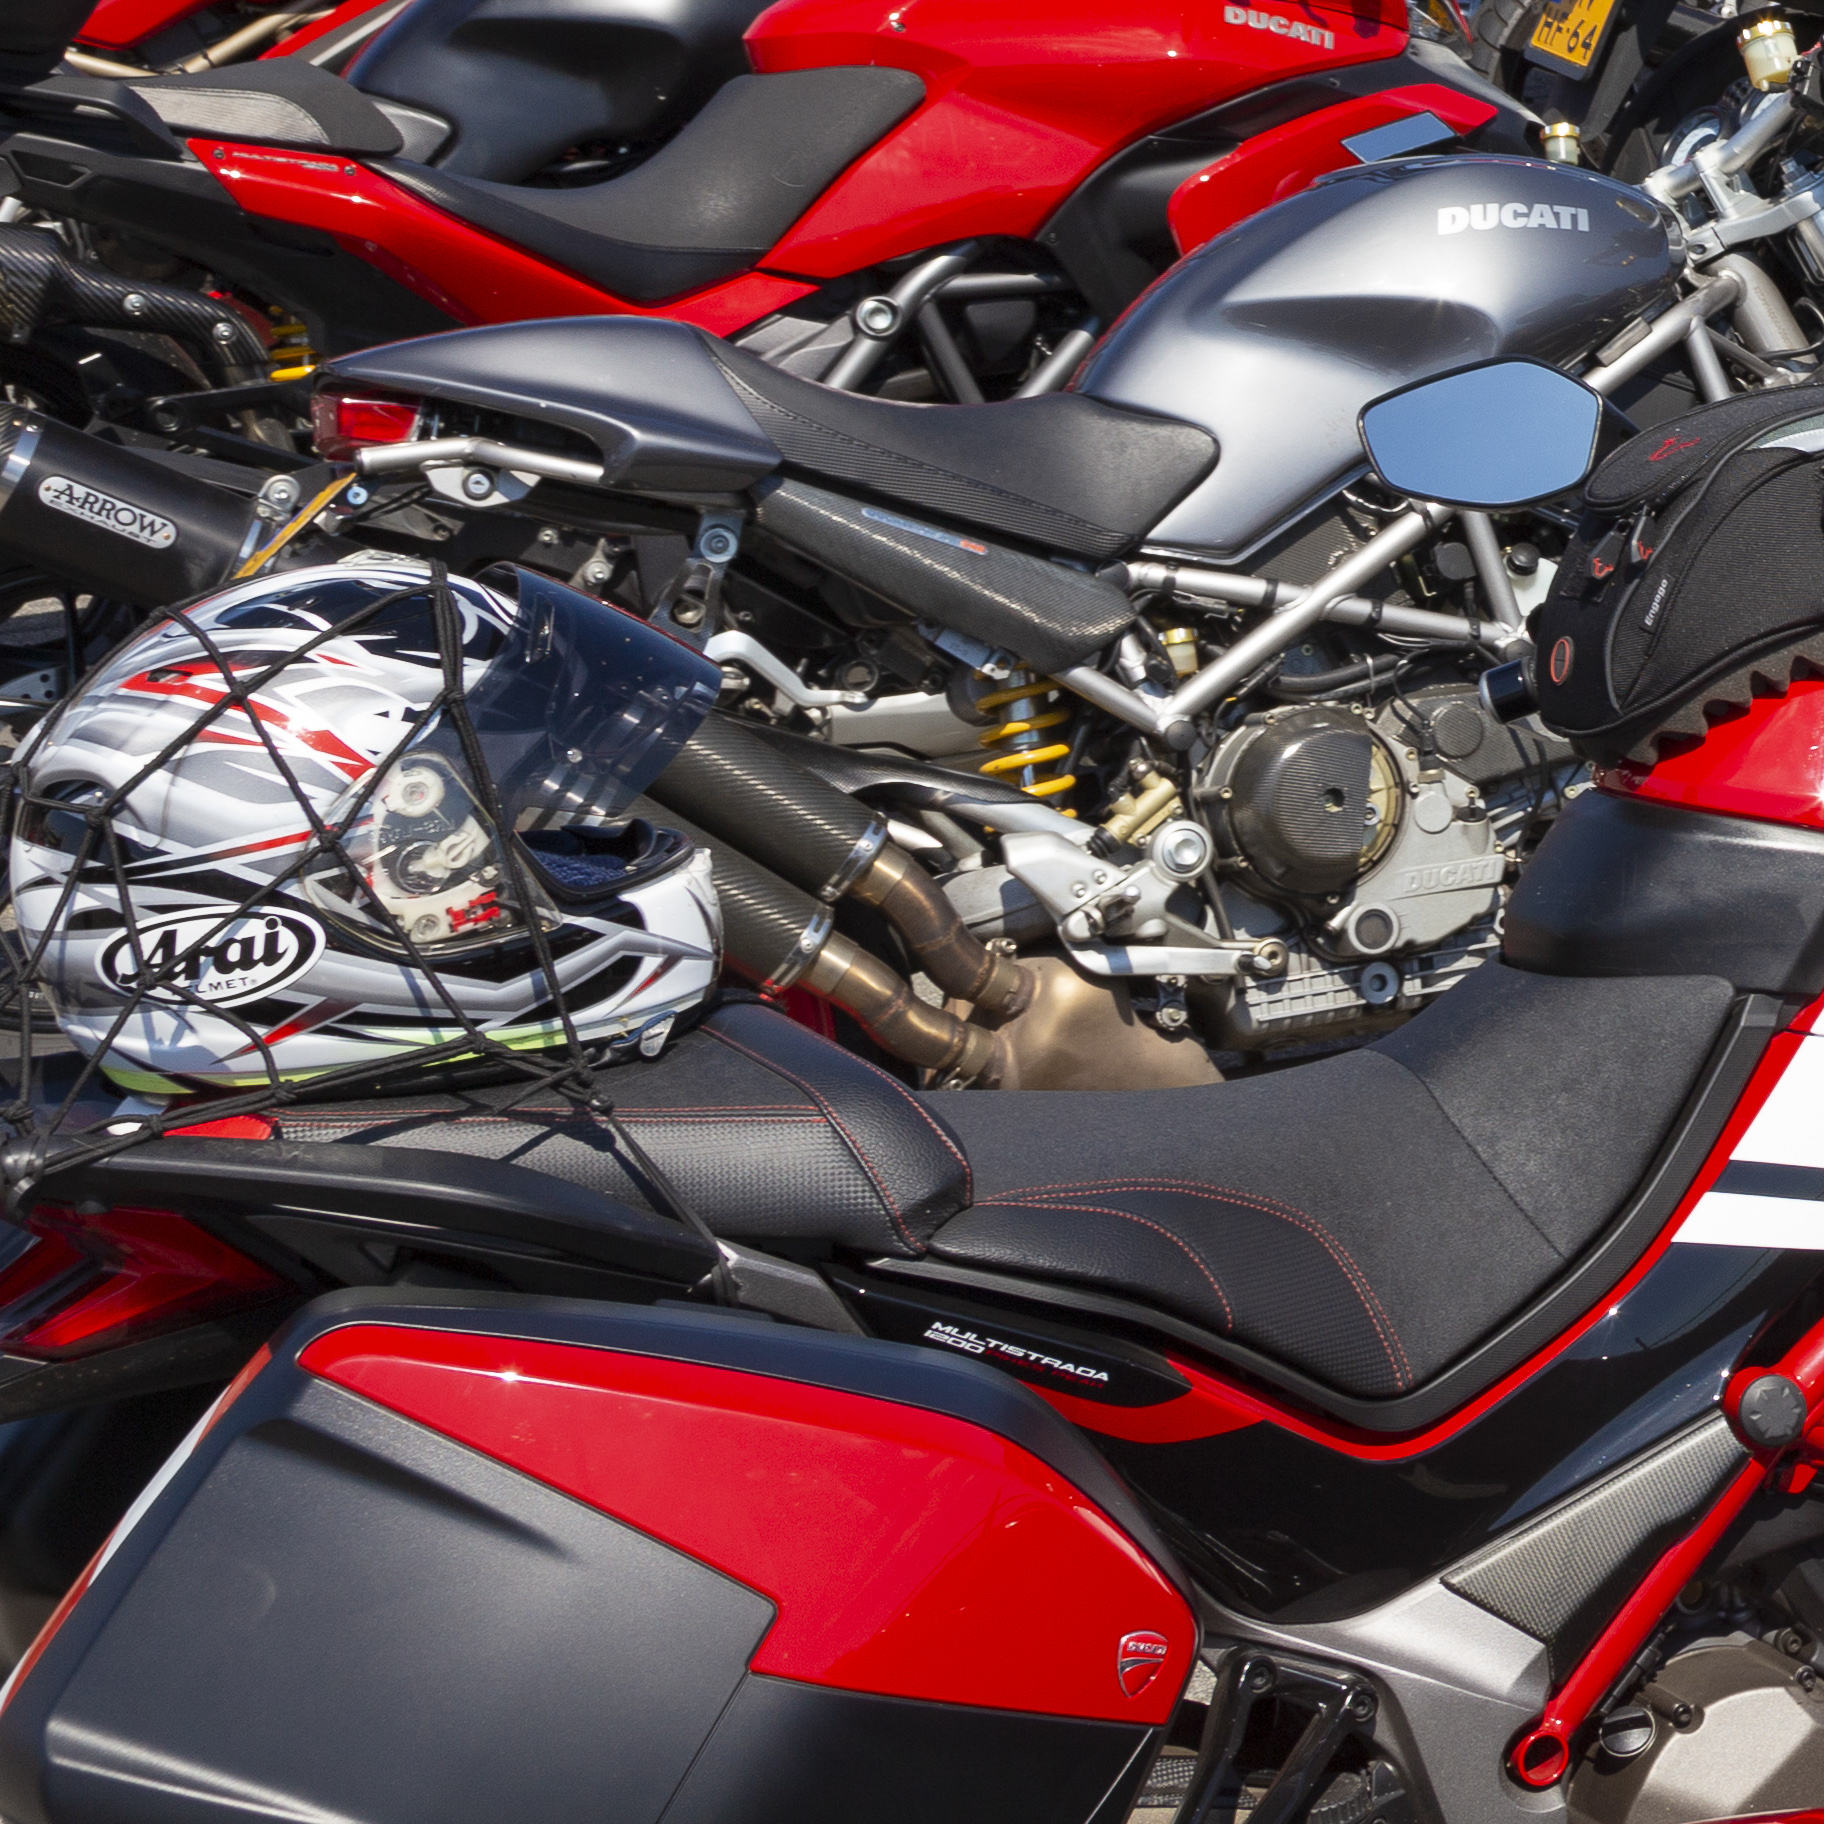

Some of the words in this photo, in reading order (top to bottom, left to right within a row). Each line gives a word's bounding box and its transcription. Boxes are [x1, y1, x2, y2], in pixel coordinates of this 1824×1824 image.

[1224, 5, 1335, 50] DUCATI
[1536, 8, 1598, 61] HF-64
[1436, 202, 1589, 235] DUCATI
[48, 498, 158, 544] EXHAUST
[52, 483, 170, 539] ARROW
[1404, 858, 1502, 894] DUCATI
[117, 916, 280, 988] Arai
[924, 1329, 986, 1356] 1200
[986, 1346, 1044, 1375] PIKES
[1052, 1363, 1106, 1389] PEAK
[931, 1320, 1110, 1382] MULTISTRADA
[1127, 1641, 1168, 1656] DUCATI
